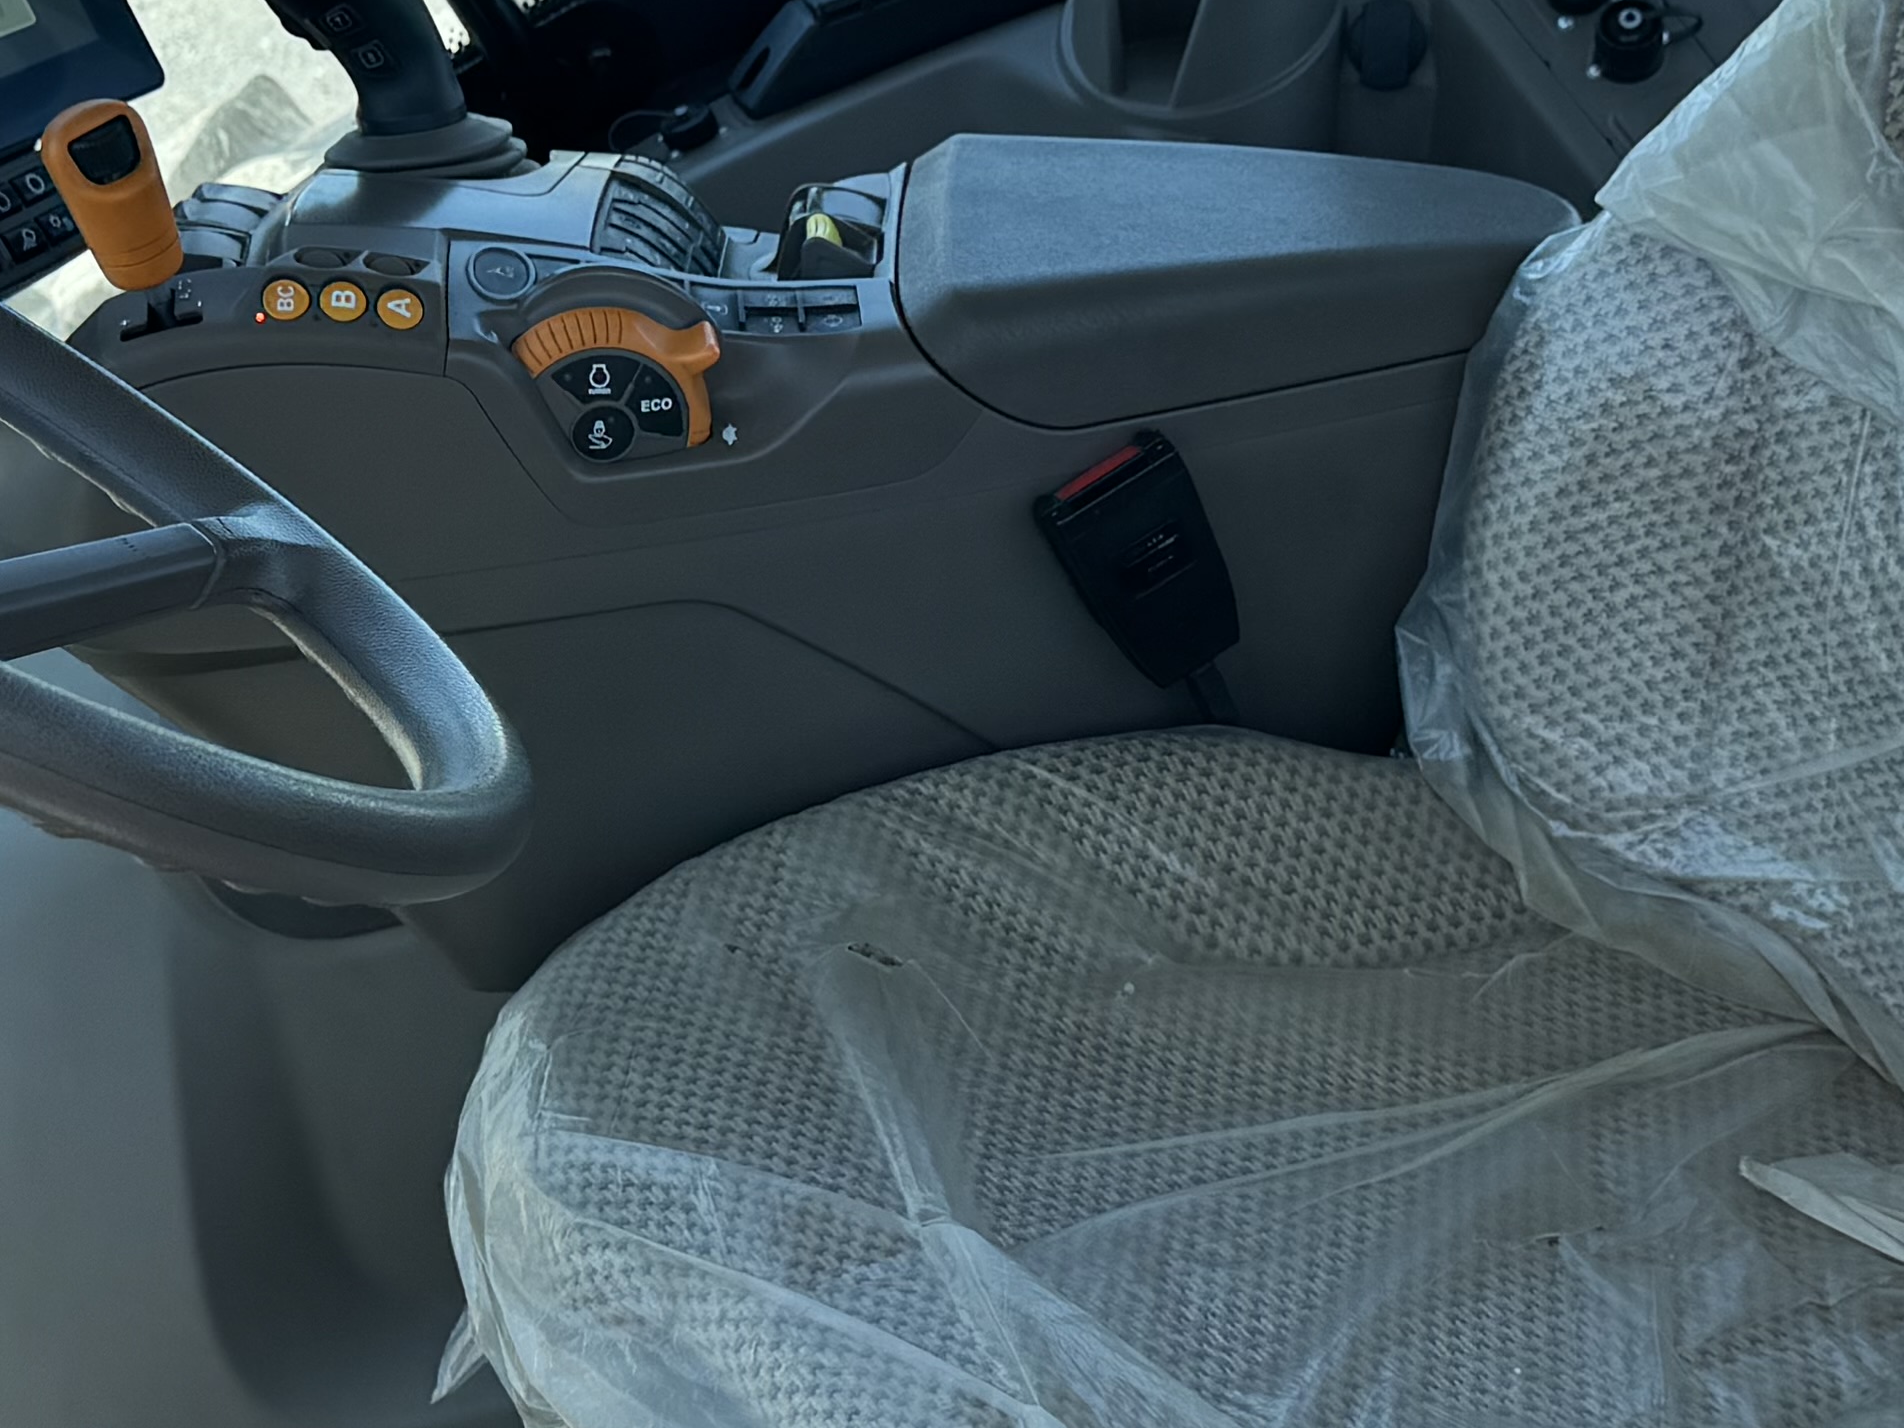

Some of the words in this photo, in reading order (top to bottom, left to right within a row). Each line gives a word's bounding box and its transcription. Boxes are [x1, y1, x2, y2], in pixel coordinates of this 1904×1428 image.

[277, 285, 295, 312] BC
[331, 289, 357, 309] B
[387, 297, 412, 318] A
[640, 397, 673, 412] ECO
